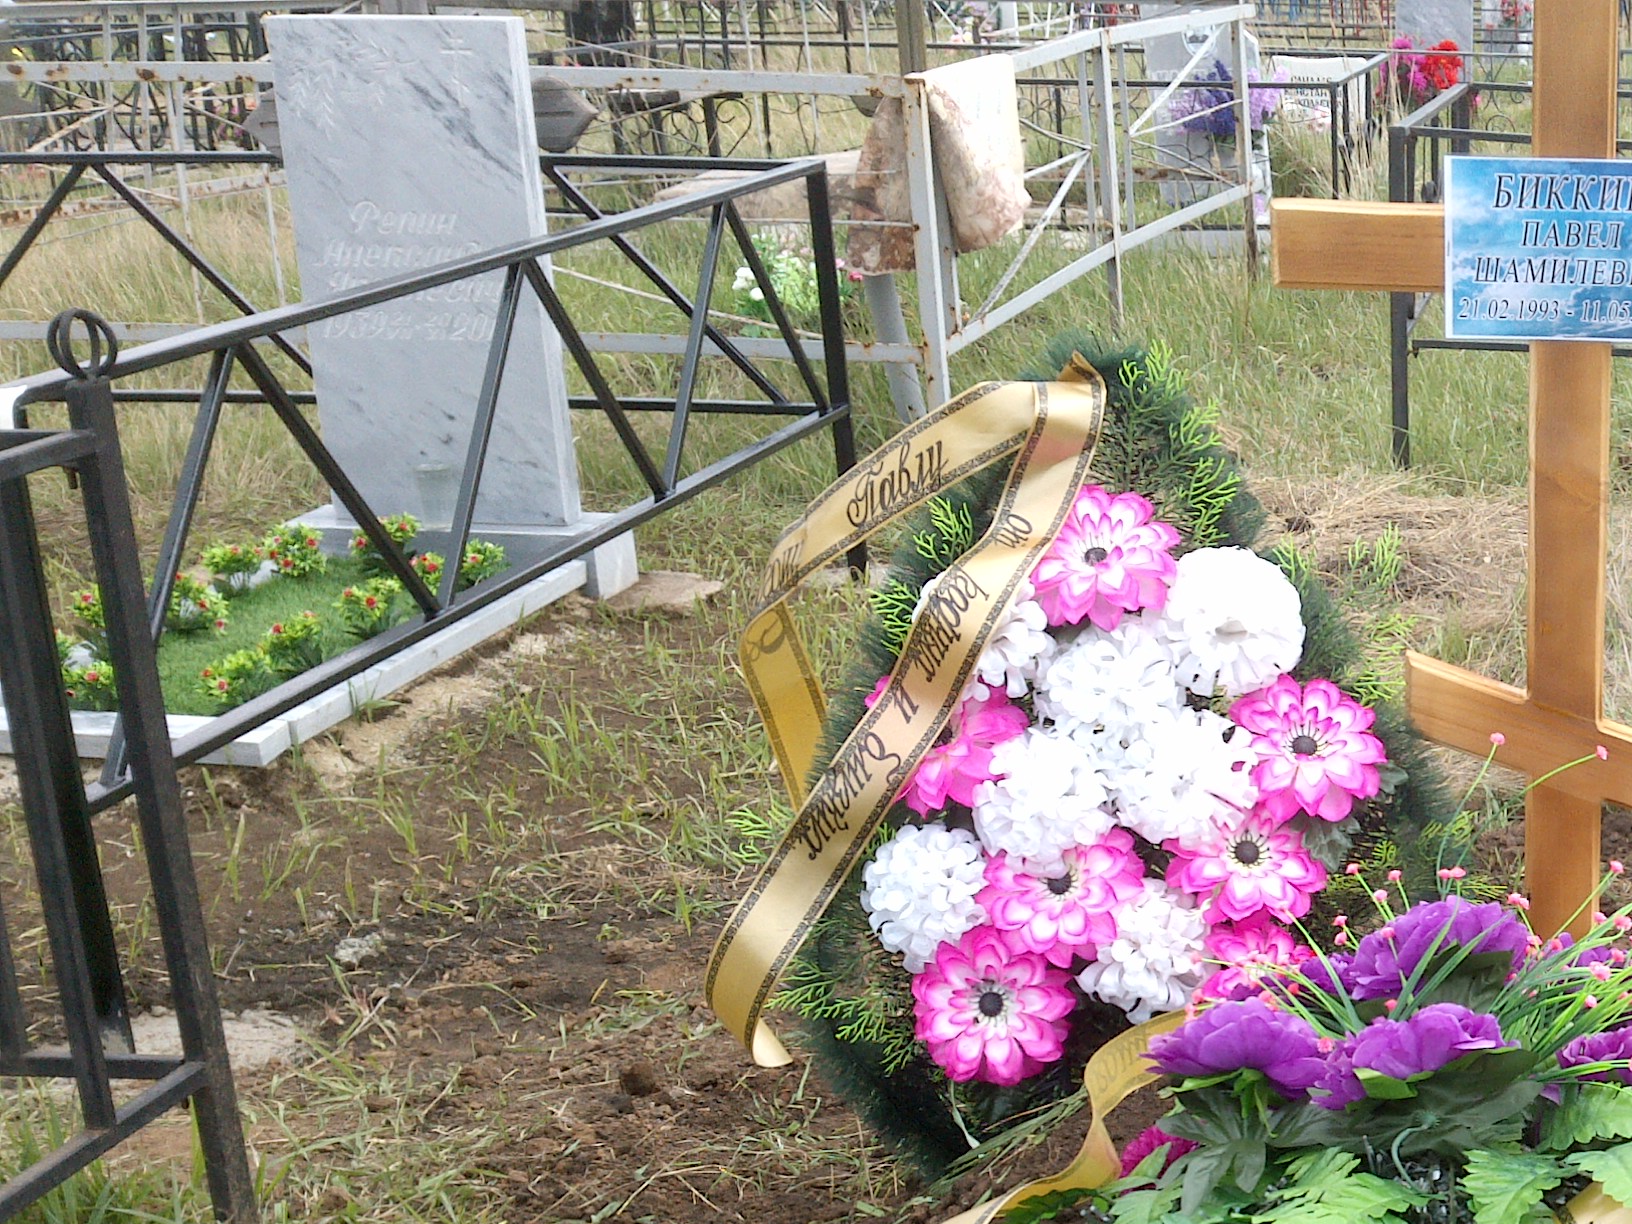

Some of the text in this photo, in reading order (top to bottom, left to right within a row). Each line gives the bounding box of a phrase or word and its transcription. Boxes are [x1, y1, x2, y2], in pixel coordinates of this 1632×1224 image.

[1521, 220, 1624, 250] ПАВЕЛ
[1457, 298, 1560, 321] 21.02.1993
[846, 437, 948, 529] Павлу
[994, 511, 1033, 549] от
[892, 681, 919, 725] и
